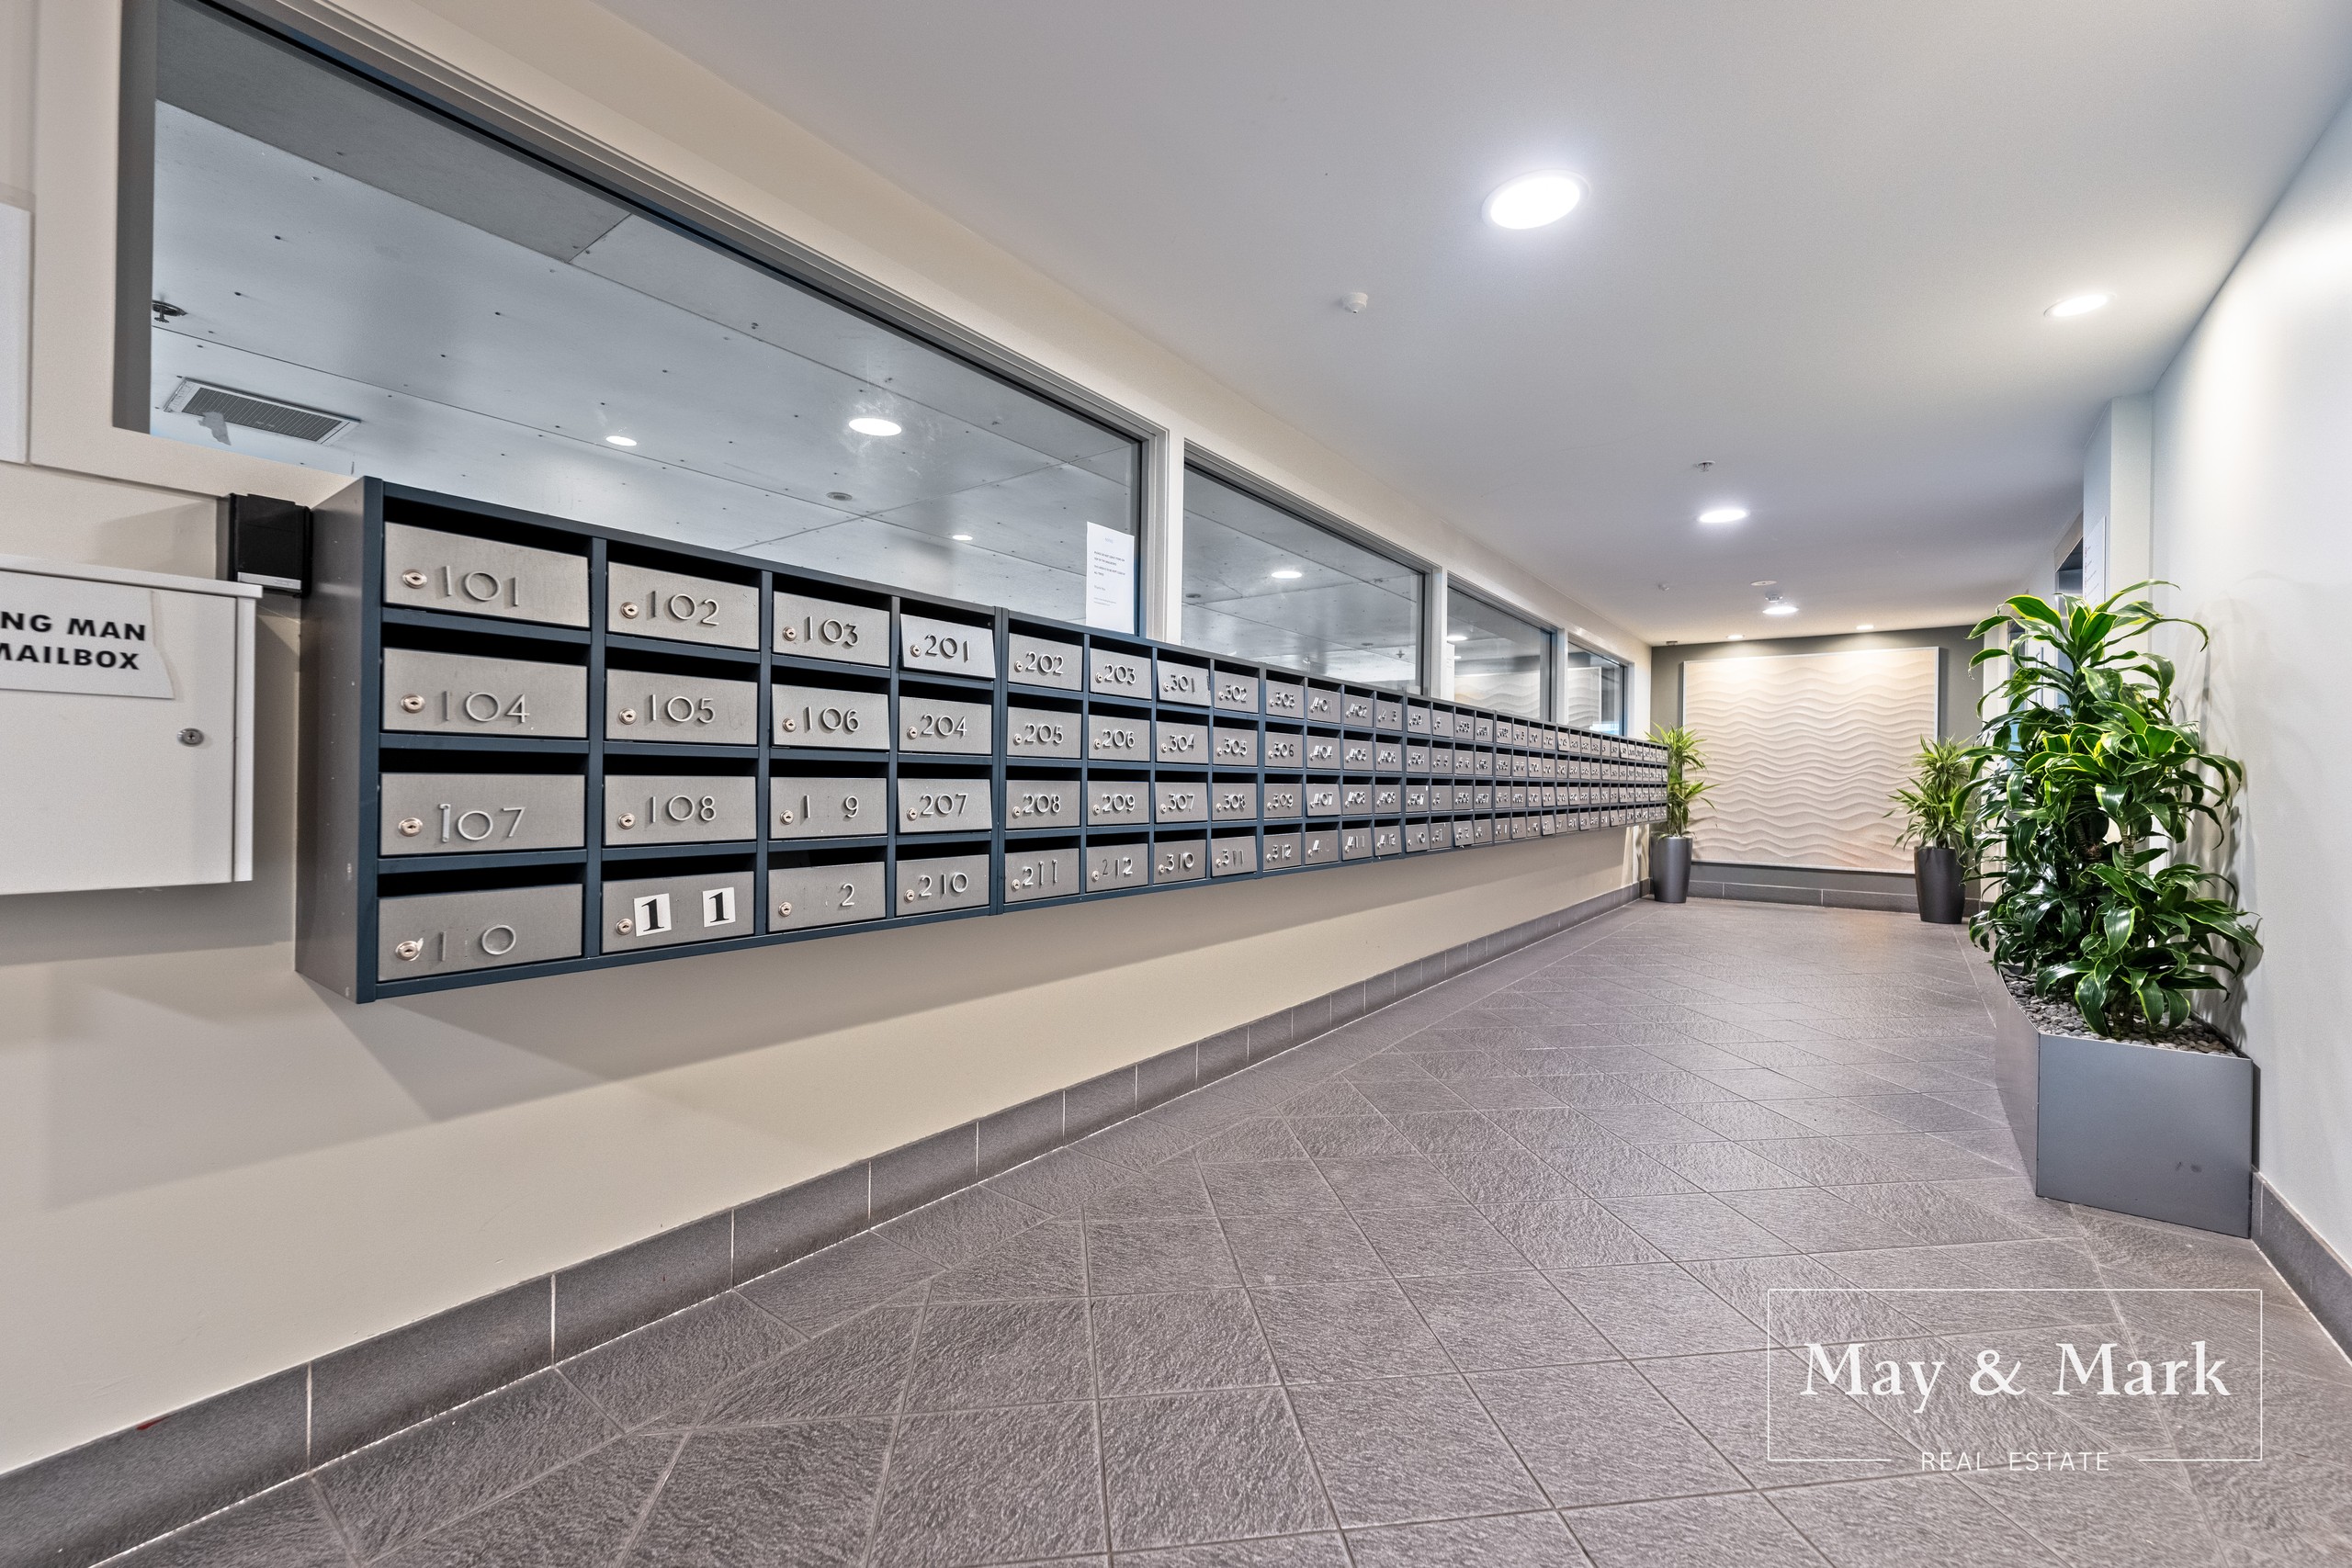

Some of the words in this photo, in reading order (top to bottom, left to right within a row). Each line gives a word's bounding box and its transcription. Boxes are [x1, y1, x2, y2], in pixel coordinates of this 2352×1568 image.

[445, 564, 518, 607] 101
[651, 590, 719, 626] 102
[67, 618, 146, 641] MAN
[807, 616, 858, 647] 103
[924, 634, 970, 662] 201
[1025, 651, 1064, 675] 202
[1104, 663, 1136, 684] 203
[1170, 673, 1195, 694] 301
[1225, 684, 1247, 703] 302
[445, 690, 530, 724] 104
[650, 694, 716, 724] 105
[1275, 692, 1295, 707] 303
[1349, 703, 1367, 717] 402
[807, 706, 860, 732] 106
[921, 713, 967, 738] 204
[1023, 724, 1064, 745] 205
[1102, 729, 1136, 749] 206
[1169, 733, 1194, 752] 304
[1224, 738, 1247, 757] 305
[1274, 742, 1295, 757] 306
[1313, 745, 1333, 759] 404
[1349, 748, 1367, 761] 405
[921, 792, 968, 816] 207
[1022, 793, 1061, 814] 208
[1102, 793, 1136, 813] 209
[1168, 794, 1195, 813] 307
[1223, 794, 1246, 810] 308
[1272, 793, 1294, 807] 309
[1348, 792, 1366, 804] 408
[651, 795, 717, 823] 108
[439, 802, 526, 843] 107
[1272, 844, 1292, 859] 312
[1347, 836, 1365, 848] 411
[1102, 857, 1133, 876] 212
[1165, 852, 1195, 871] 310
[1221, 849, 1244, 865] 311
[1023, 859, 1057, 886] 211
[840, 882, 855, 907] 2
[919, 872, 968, 897] 210
